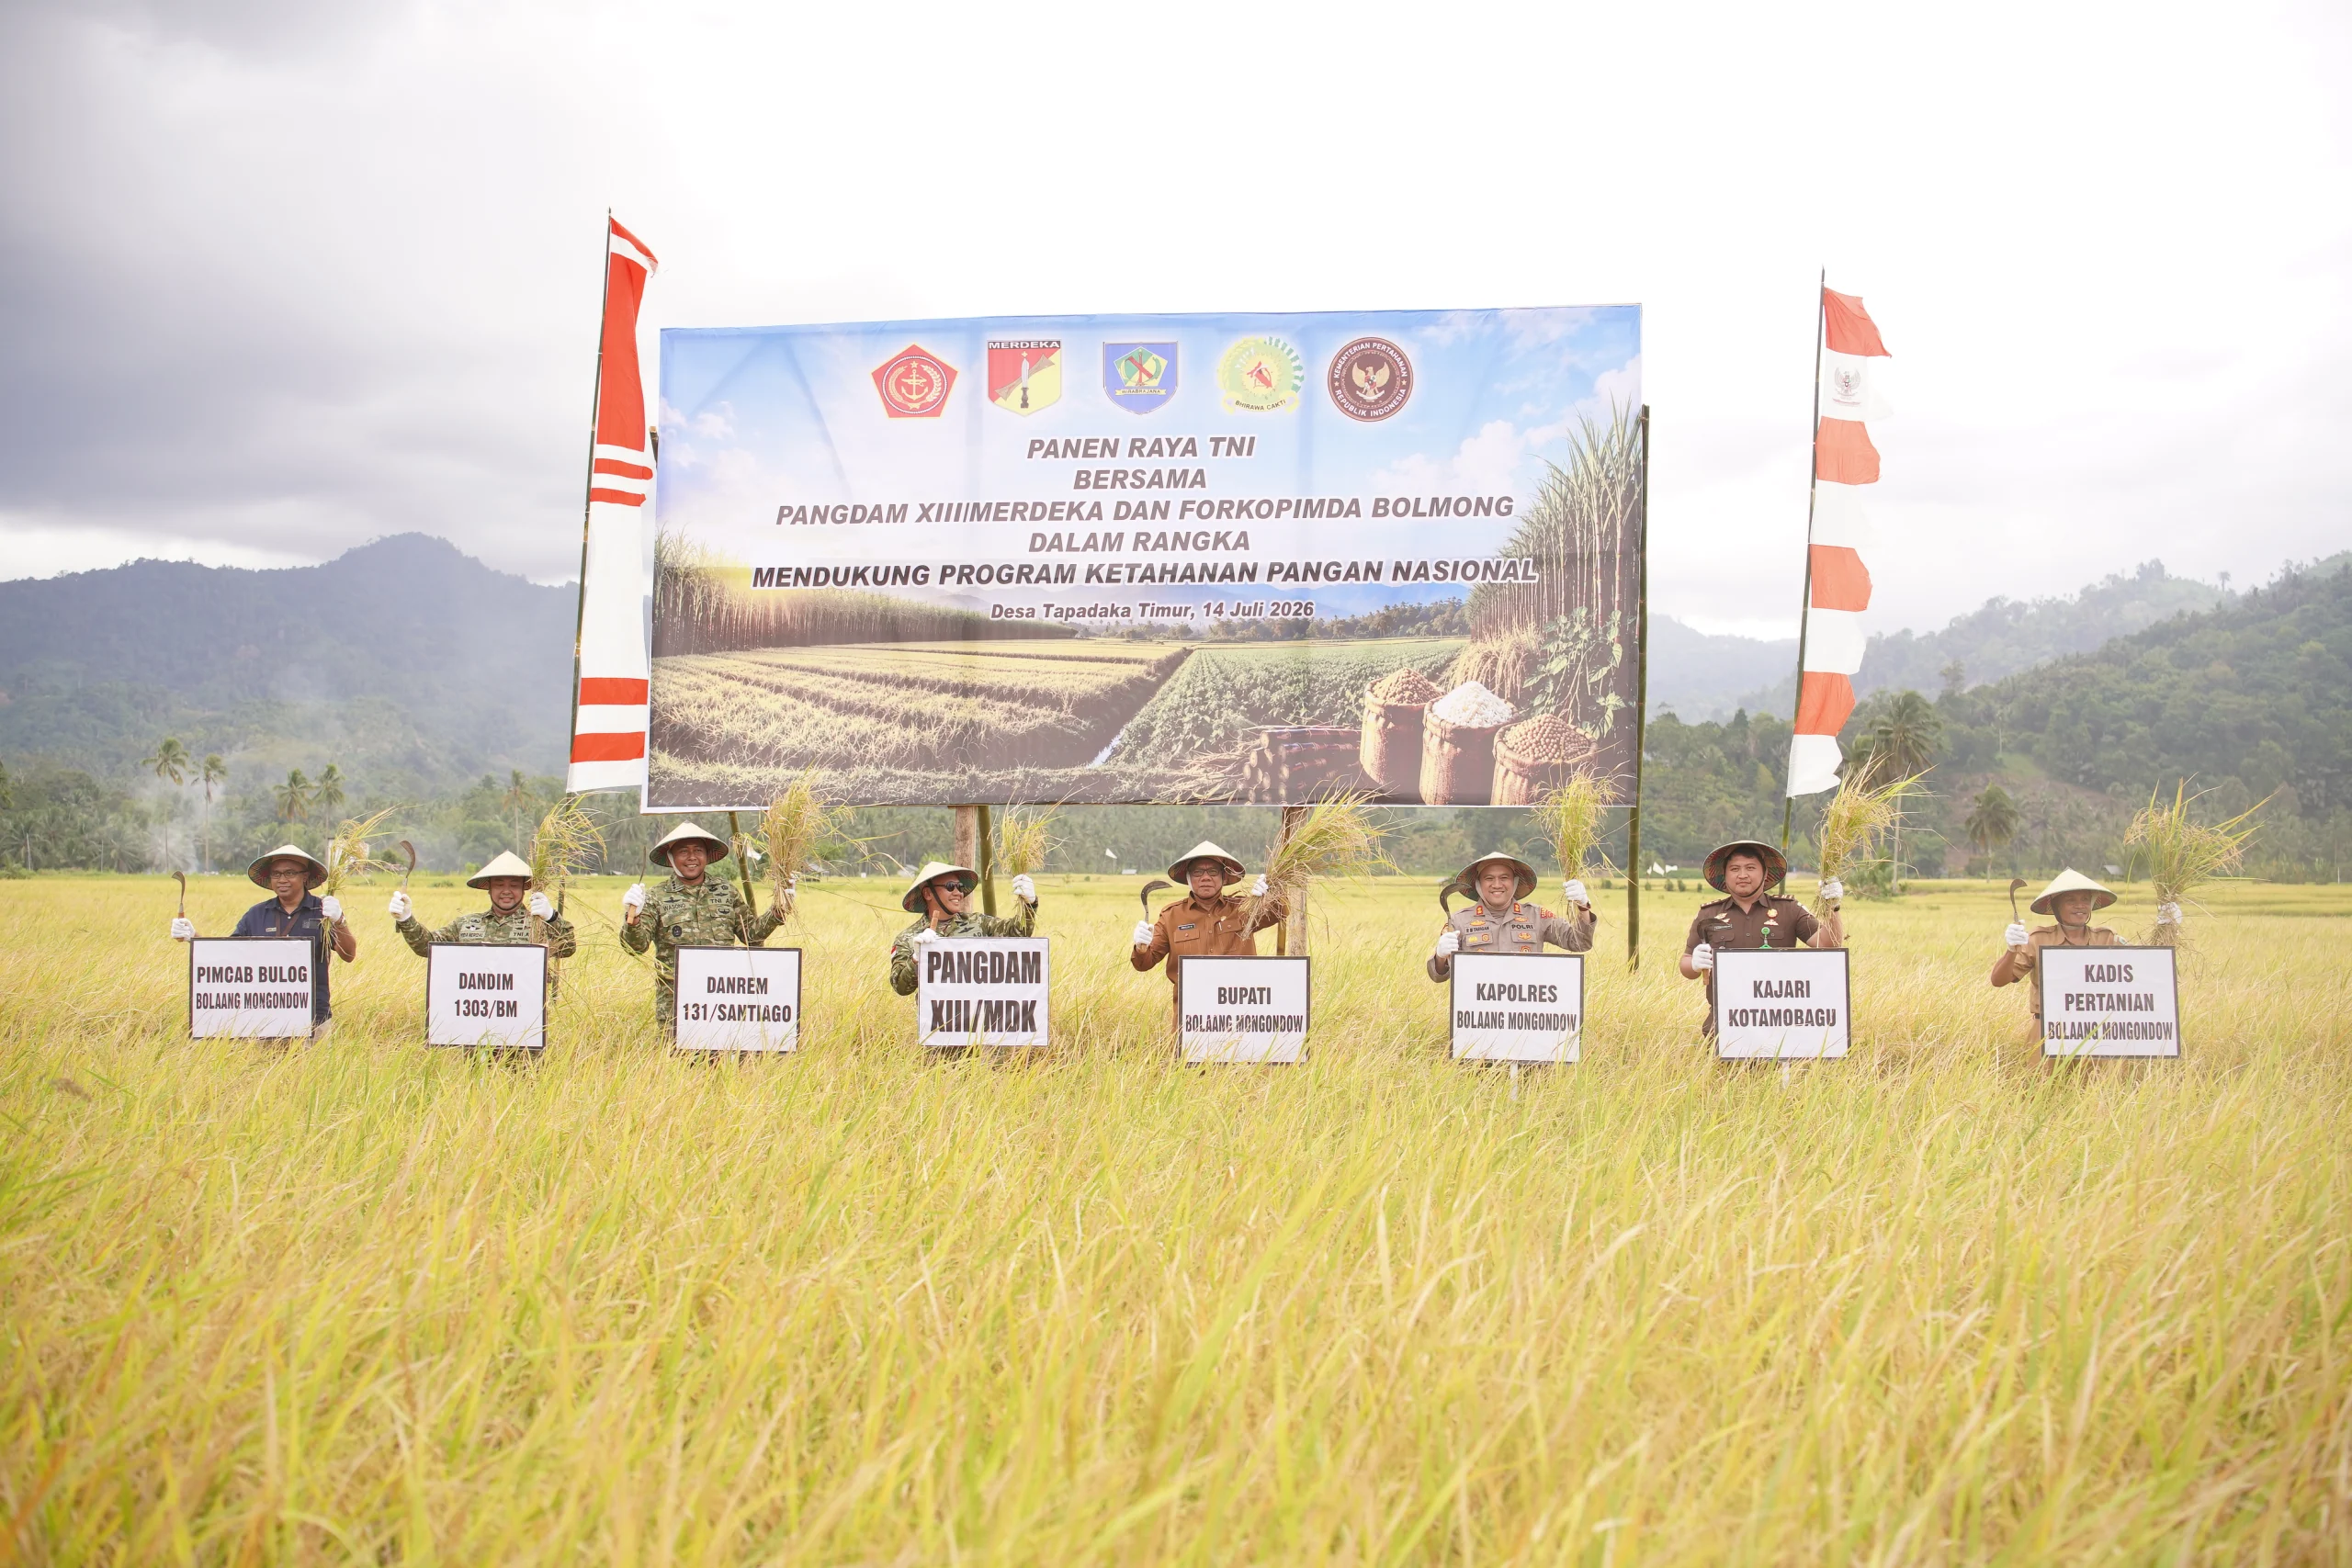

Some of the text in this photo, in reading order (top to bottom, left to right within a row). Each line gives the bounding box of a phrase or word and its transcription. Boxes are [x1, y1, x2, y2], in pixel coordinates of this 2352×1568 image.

[989, 341, 1060, 349] MERDEKA
[1334, 343, 1408, 378] KEMENTERIAN PERTAHANAN
[1235, 400, 1286, 411] BHIRAWA CAKTI
[1335, 389, 1407, 416] REPUBLIK INDONESIA
[1027, 436, 1256, 458] PANEN RAYA TNI
[1073, 468, 1206, 490] BERSAMA
[776, 503, 908, 525] PANGDAM
[1113, 501, 1170, 520] DAN
[1179, 498, 1362, 520] FORKOPIMDA
[1371, 496, 1514, 518] BOLMONG
[1028, 531, 1250, 552] DALAM RANGKA
[752, 559, 1538, 588] MENDUKUNG PROGRAM KETAHANAN PANGAN NASIONAL
[990, 601, 1315, 621] Desa Tapadaka Timur, 14 Juli 2026
[662, 903, 686, 911] WASONO
[197, 965, 308, 983] PIMCAB BULOG
[927, 951, 1041, 984] PANGDAM
[2085, 964, 2133, 983] KADIS
[458, 972, 514, 990] DANDIM
[707, 976, 768, 995] DANREM
[1753, 980, 1811, 998] KAJARI
[196, 992, 309, 1010] BOLAANG MONGONDOW
[1217, 987, 1272, 1005] BUPATI
[1476, 983, 1558, 1003] KAPOLRES
[2064, 993, 2154, 1011] PERTANIAN
[454, 999, 517, 1019] 1303/BM
[683, 1003, 792, 1023] 131/SANTIAGO
[931, 999, 1037, 1032] XIII/MDK
[1728, 1009, 1837, 1027] KOTAMOBAGU
[1185, 1014, 1304, 1032] BOLAANG MONGONDOW
[1456, 1010, 1577, 1032] BOLAANG MONGONDOW
[2048, 1021, 2173, 1041] BOLAANG MONGONDOW
